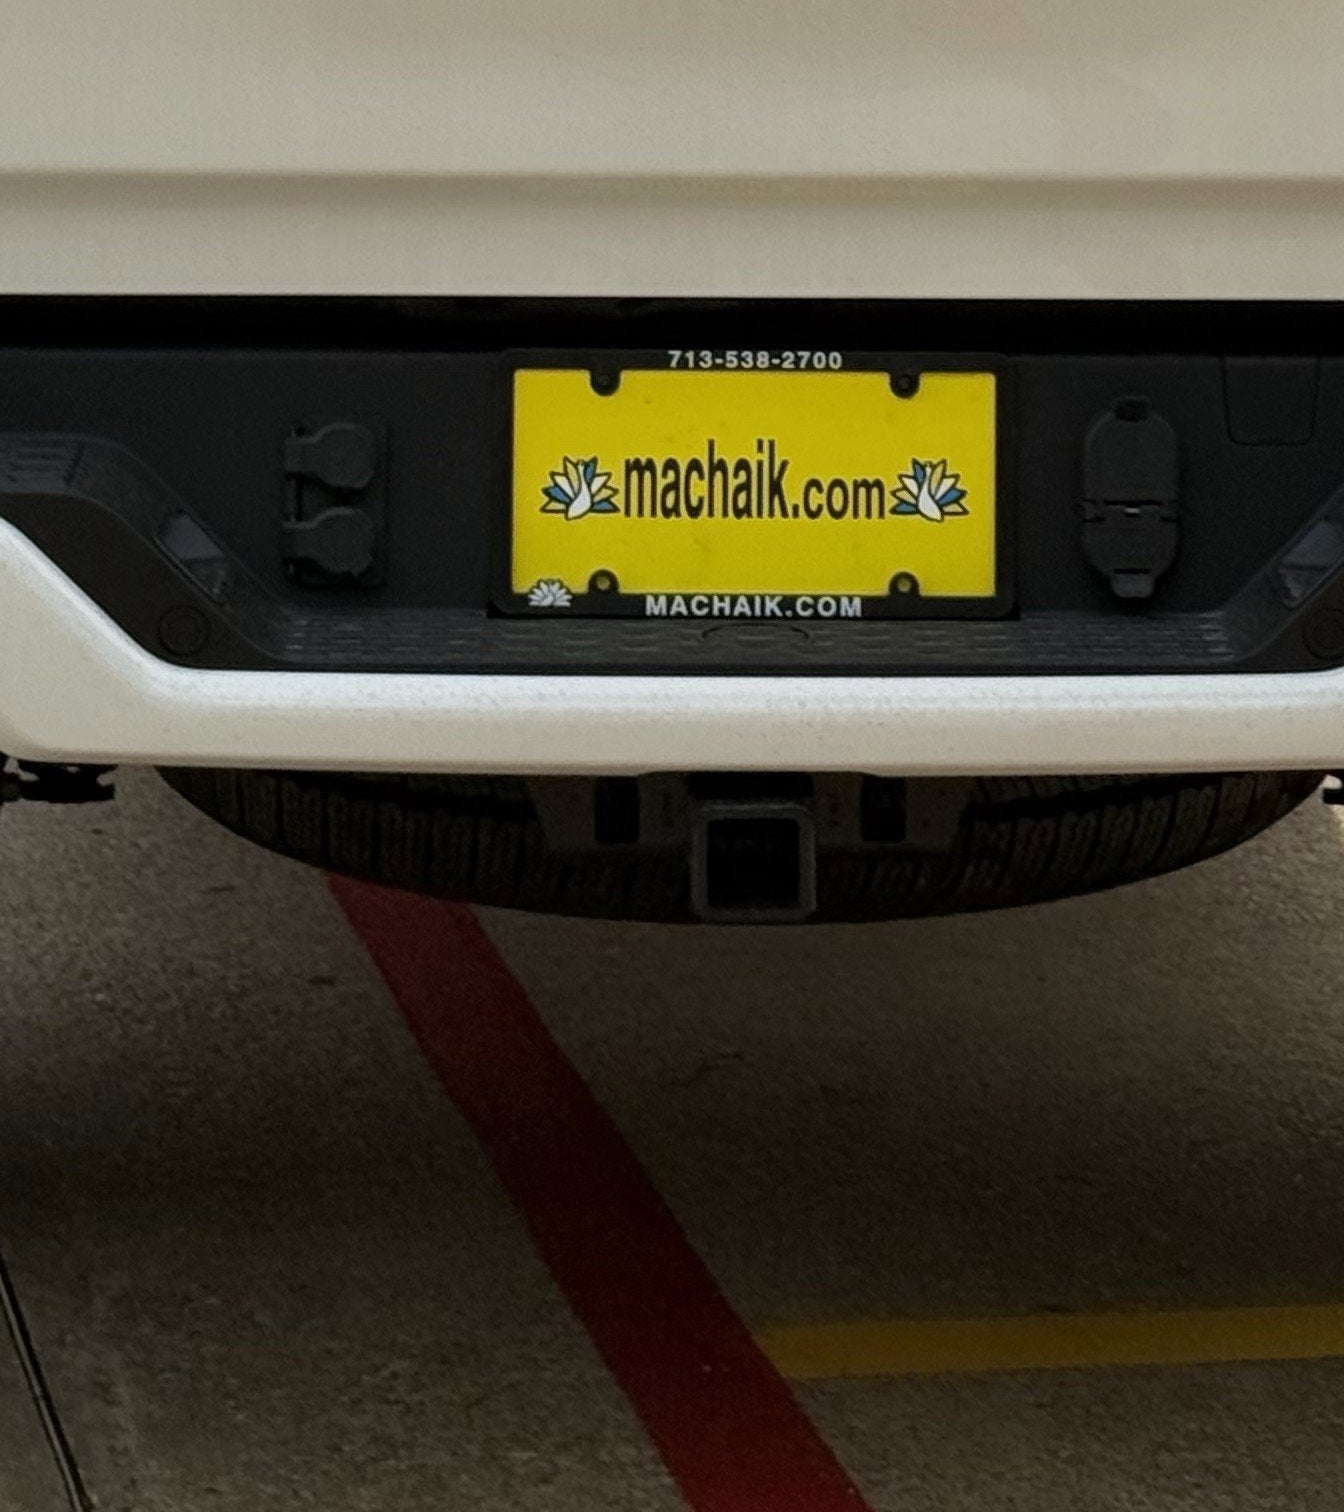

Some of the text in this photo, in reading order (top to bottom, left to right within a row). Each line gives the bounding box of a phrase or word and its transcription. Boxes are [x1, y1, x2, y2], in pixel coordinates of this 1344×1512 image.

[668, 350, 843, 370] 713-538-2700
[624, 438, 886, 520] machaik.com
[645, 595, 863, 618] MACHAIK.COM
